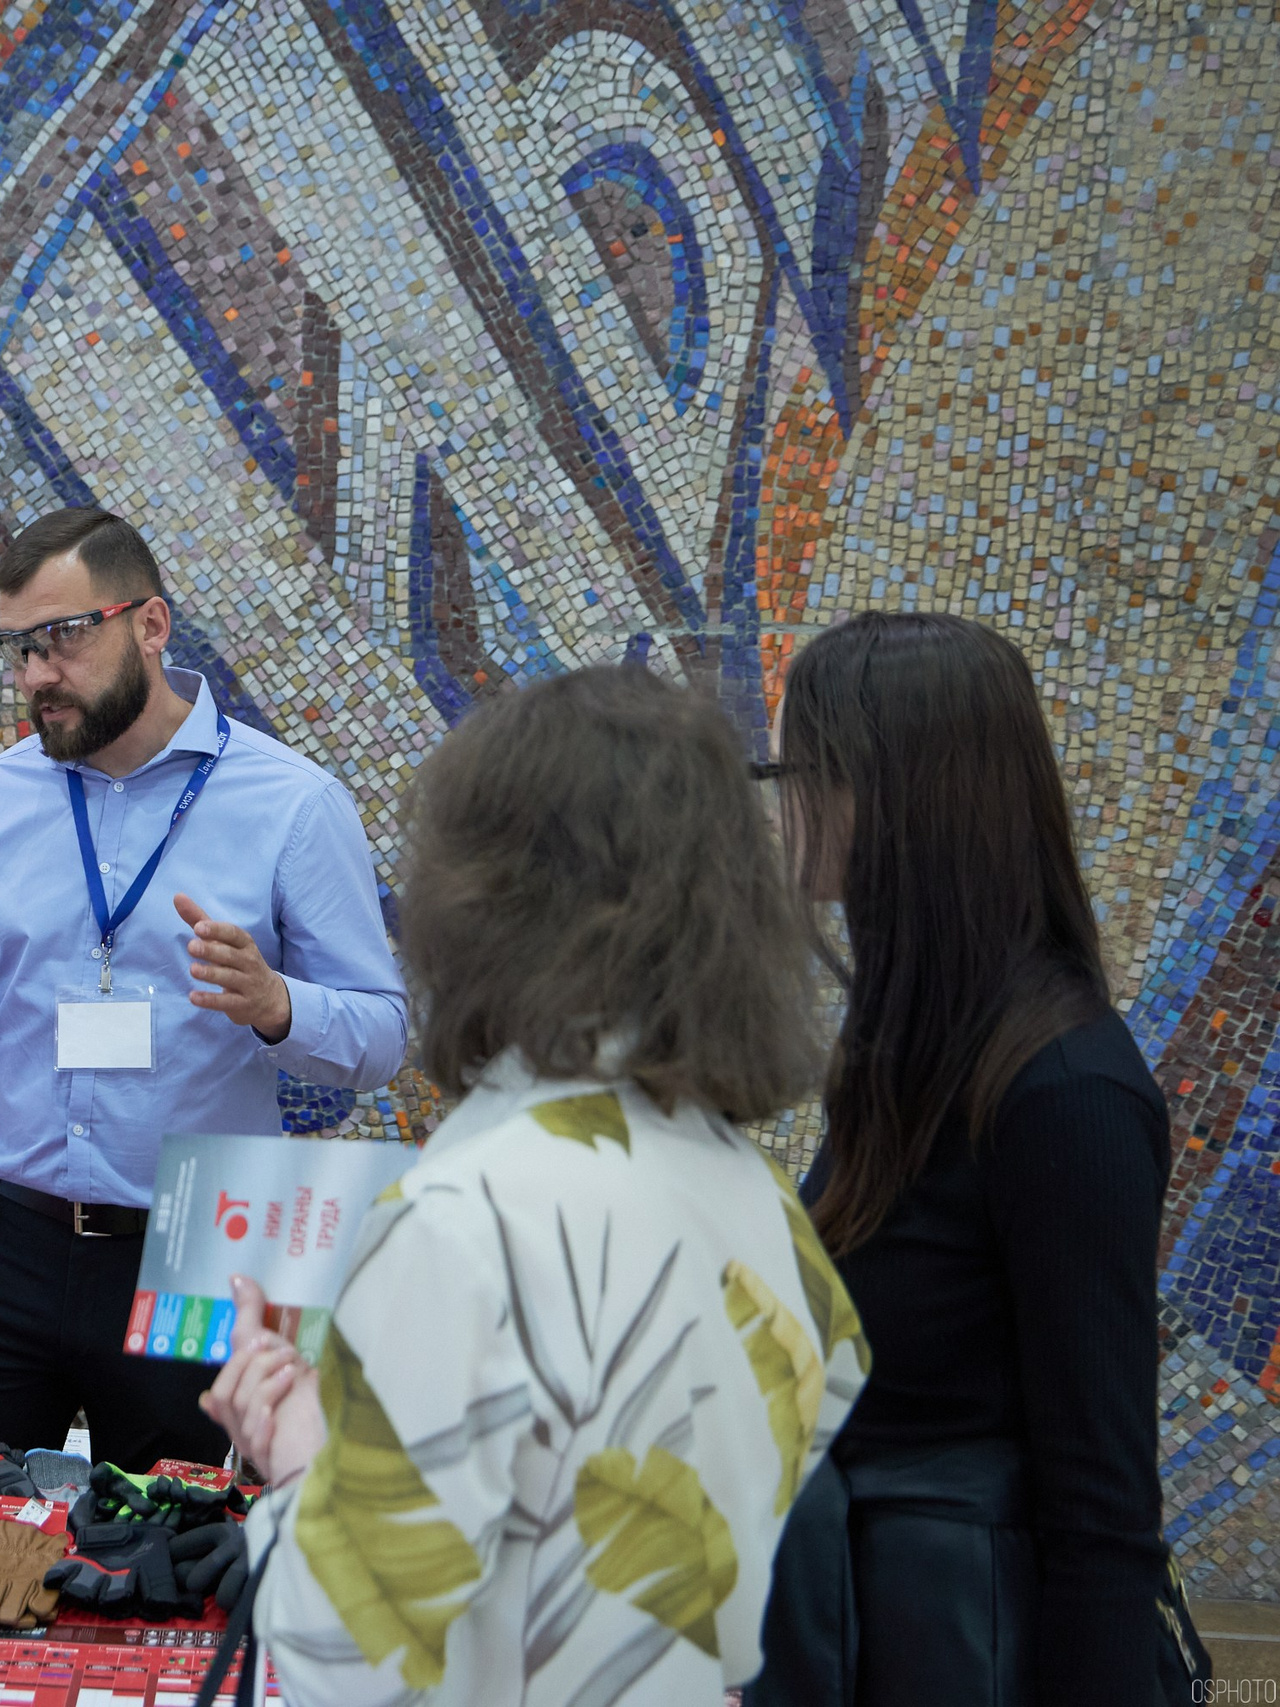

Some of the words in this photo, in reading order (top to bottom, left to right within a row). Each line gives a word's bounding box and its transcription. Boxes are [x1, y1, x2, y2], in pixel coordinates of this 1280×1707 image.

[178, 789, 195, 810] АСИЗ
[287, 1186, 313, 1257] ОХРАНЫ
[316, 1198, 341, 1251] ТРУДА
